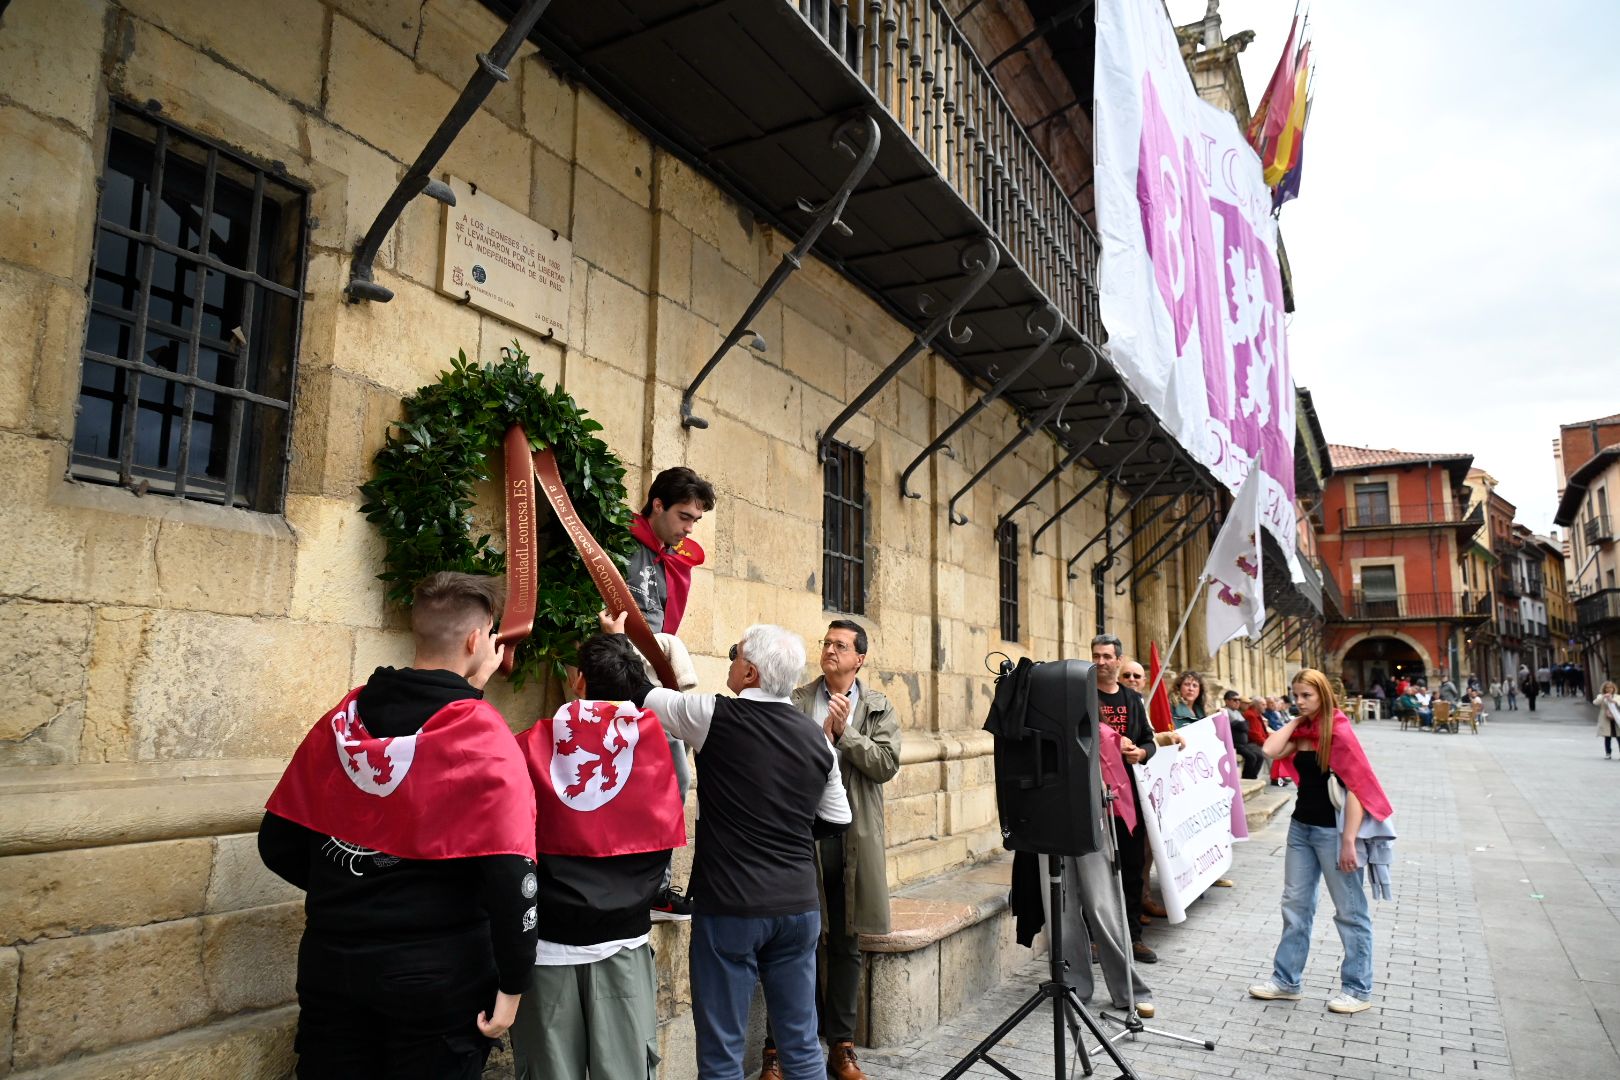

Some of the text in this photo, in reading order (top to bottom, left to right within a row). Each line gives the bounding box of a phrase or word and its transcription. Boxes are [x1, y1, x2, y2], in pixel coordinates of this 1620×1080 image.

[455, 221, 566, 284] SE LEVANTARON POR LA LIBERTAD
[456, 233, 461, 243] Y
[464, 237, 473, 249] LA
[476, 243, 526, 274] INDEPENDENCIA
[529, 269, 537, 279] DE
[539, 275, 547, 285] SU
[463, 214, 468, 223] A
[470, 218, 484, 231] LOS
[487, 226, 520, 249] LEONESES
[522, 245, 535, 258] QUE
[537, 253, 546, 263] EN
[542, 315, 549, 324] DE
[512, 479, 529, 614] ComunidadLeonesa.ES
[549, 484, 627, 612] a los Héroes Leoneses
